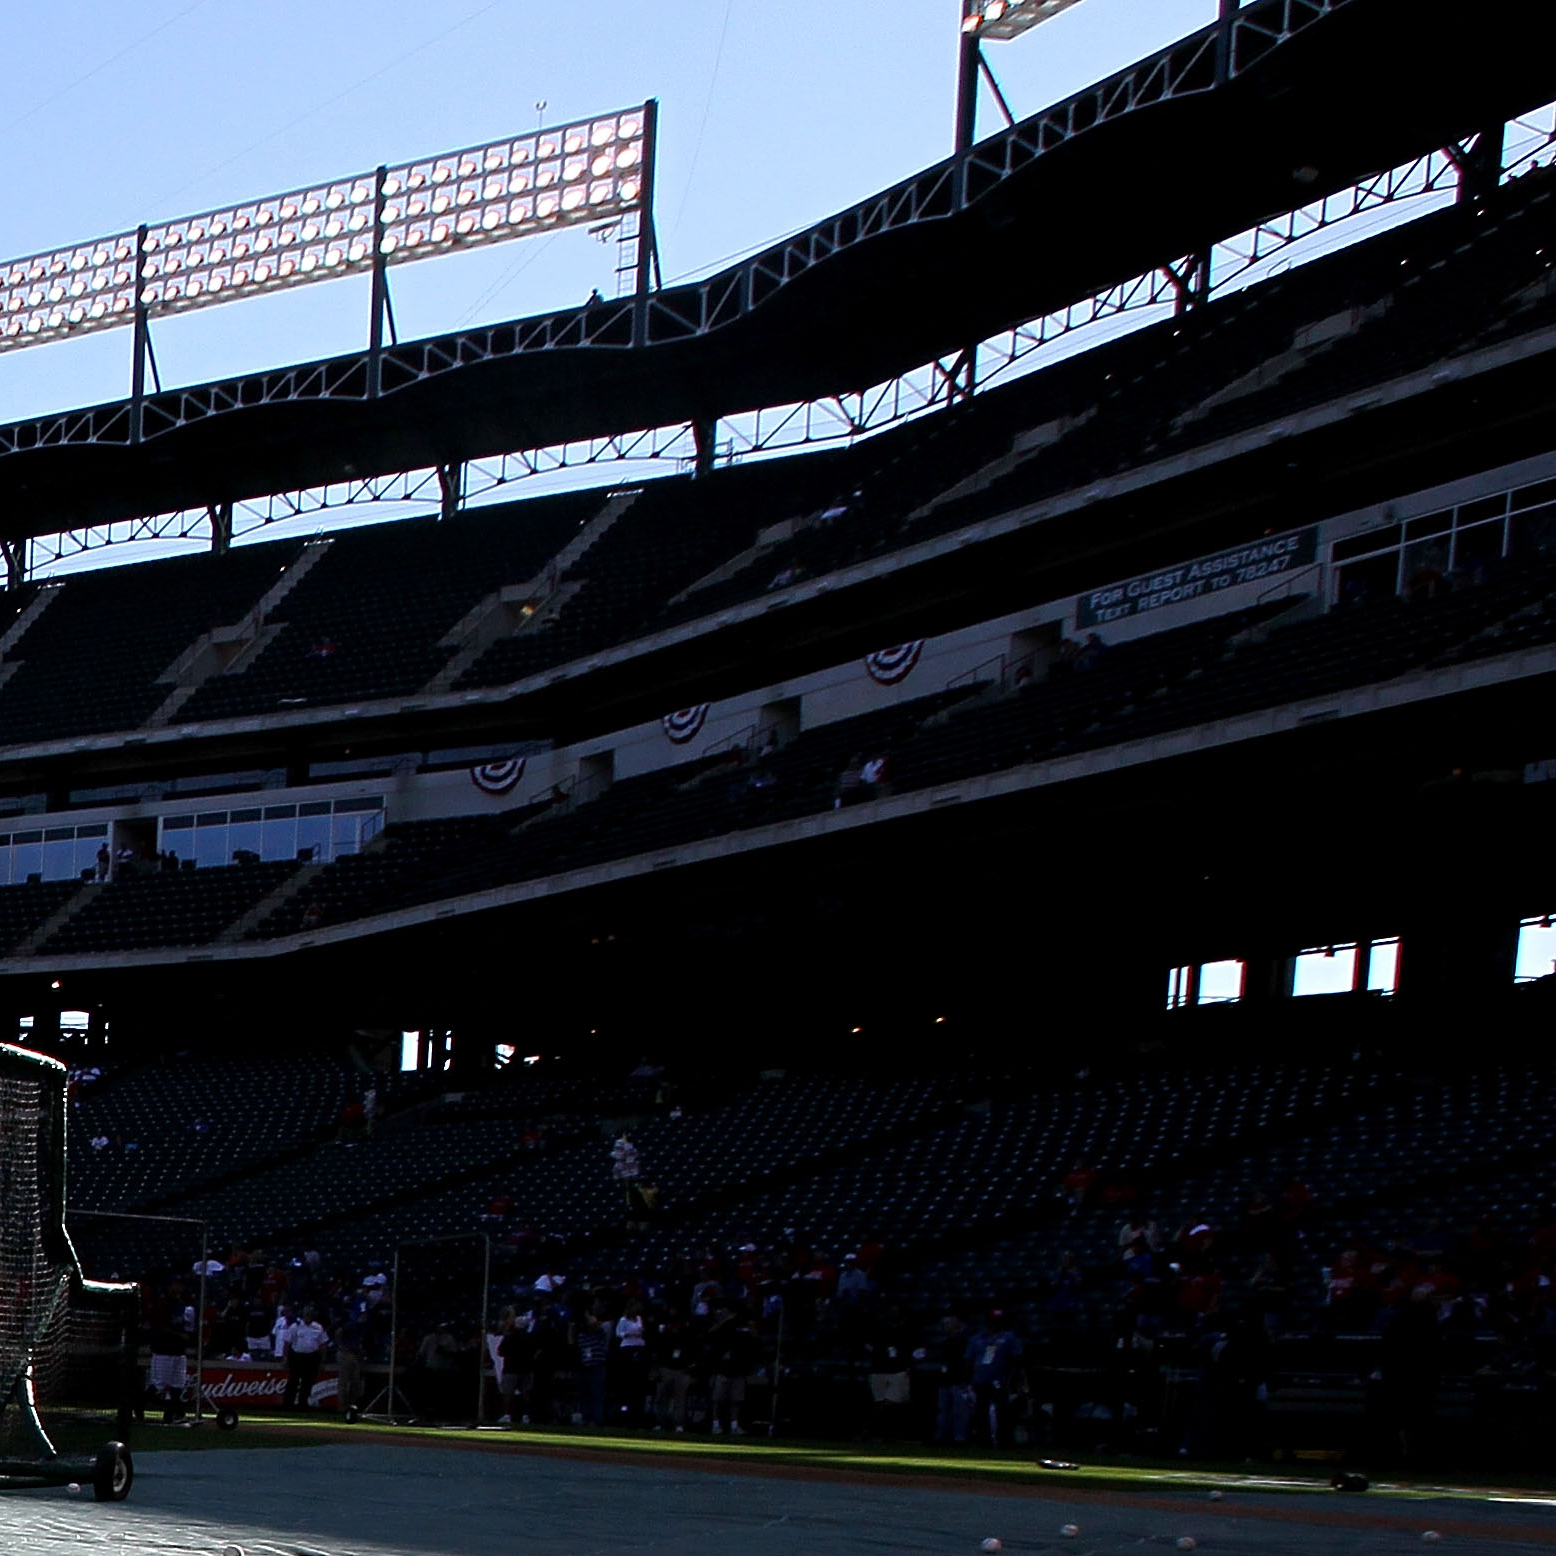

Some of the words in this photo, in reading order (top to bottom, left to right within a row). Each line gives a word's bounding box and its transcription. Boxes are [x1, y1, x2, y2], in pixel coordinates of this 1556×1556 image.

[1090, 588, 1125, 608] FOR
[1126, 570, 1186, 598] GUEST
[1187, 535, 1300, 579] ASSISTANCE
[1095, 601, 1133, 623] TEXT
[1137, 580, 1206, 612] REPORT
[1210, 573, 1232, 590] TO
[180, 1373, 289, 1402] Budweise
